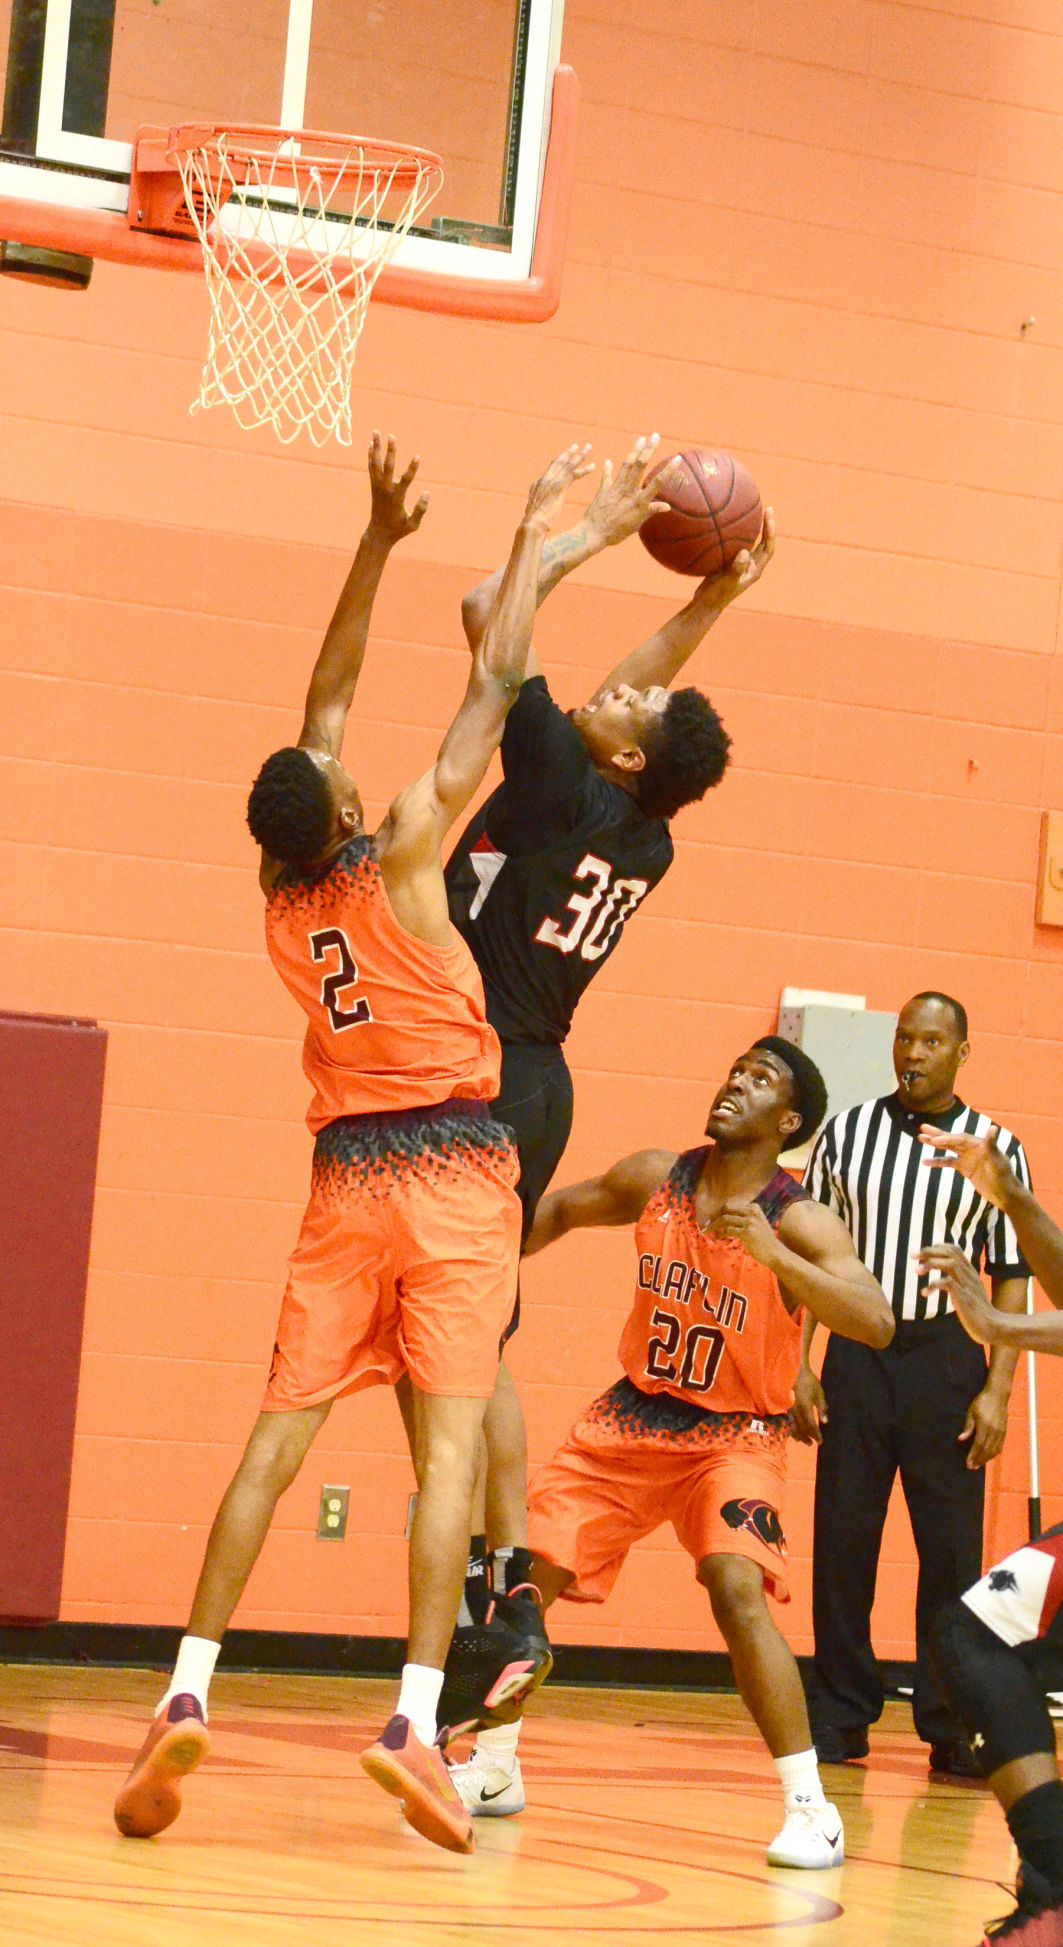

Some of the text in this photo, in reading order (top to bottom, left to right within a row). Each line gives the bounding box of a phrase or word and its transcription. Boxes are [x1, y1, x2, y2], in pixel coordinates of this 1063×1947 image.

[533, 852, 649, 961] 30
[308, 926, 373, 1034] 2
[638, 1252, 748, 1334] CLAFLIN
[643, 1305, 726, 1393] 20
